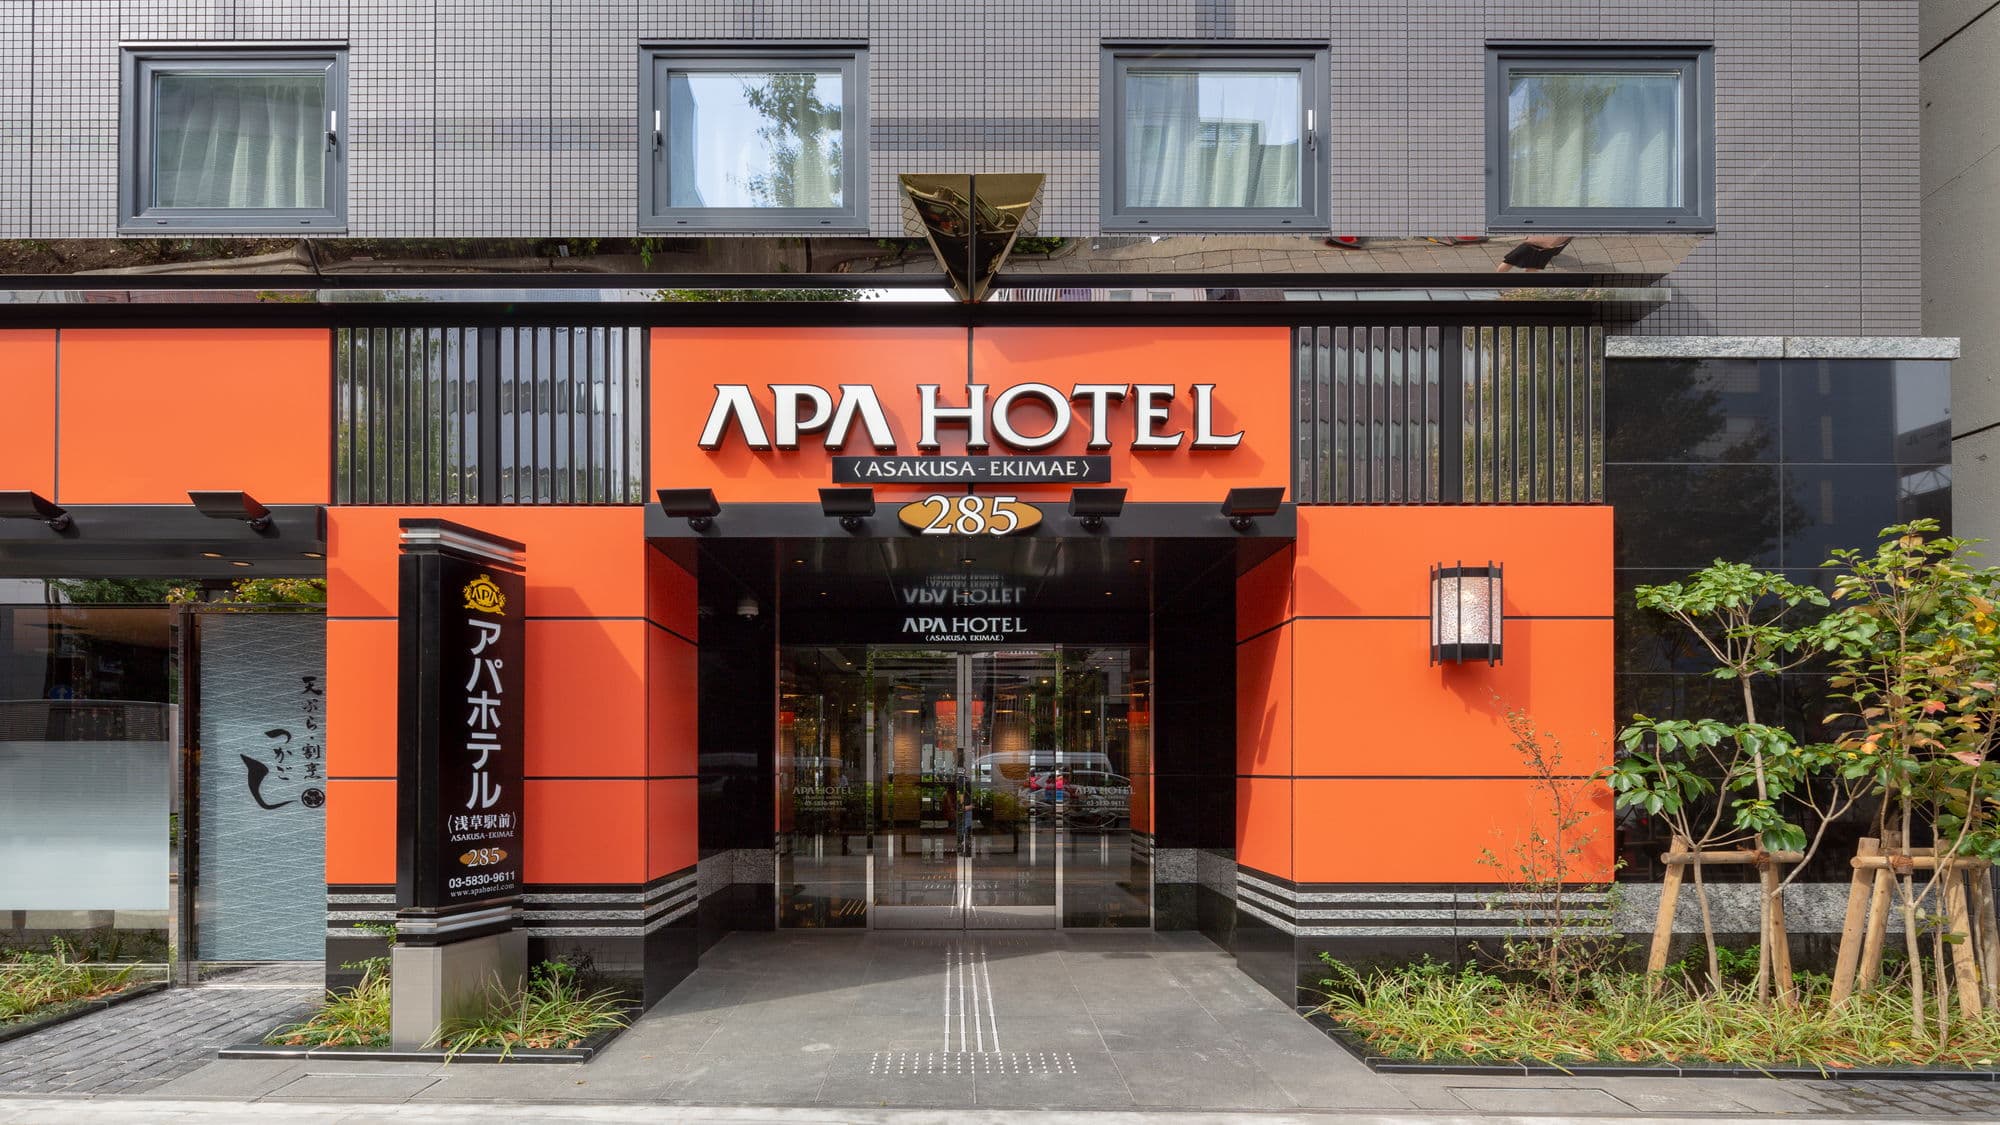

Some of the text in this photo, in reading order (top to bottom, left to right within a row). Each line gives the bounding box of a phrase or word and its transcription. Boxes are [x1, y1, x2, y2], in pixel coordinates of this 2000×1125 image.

[699, 382, 1245, 451] APA HOTEL
[922, 494, 1018, 536] 285
[472, 586, 499, 604] APA
[902, 617, 1028, 633] APA HOTEL
[465, 618, 503, 810] アパホテル
[450, 831, 515, 842] ASAKUSA-EKIMAE
[467, 847, 500, 867] 285
[448, 870, 515, 889] 03-5830-9611
[450, 883, 515, 897] www.apahotel.com
